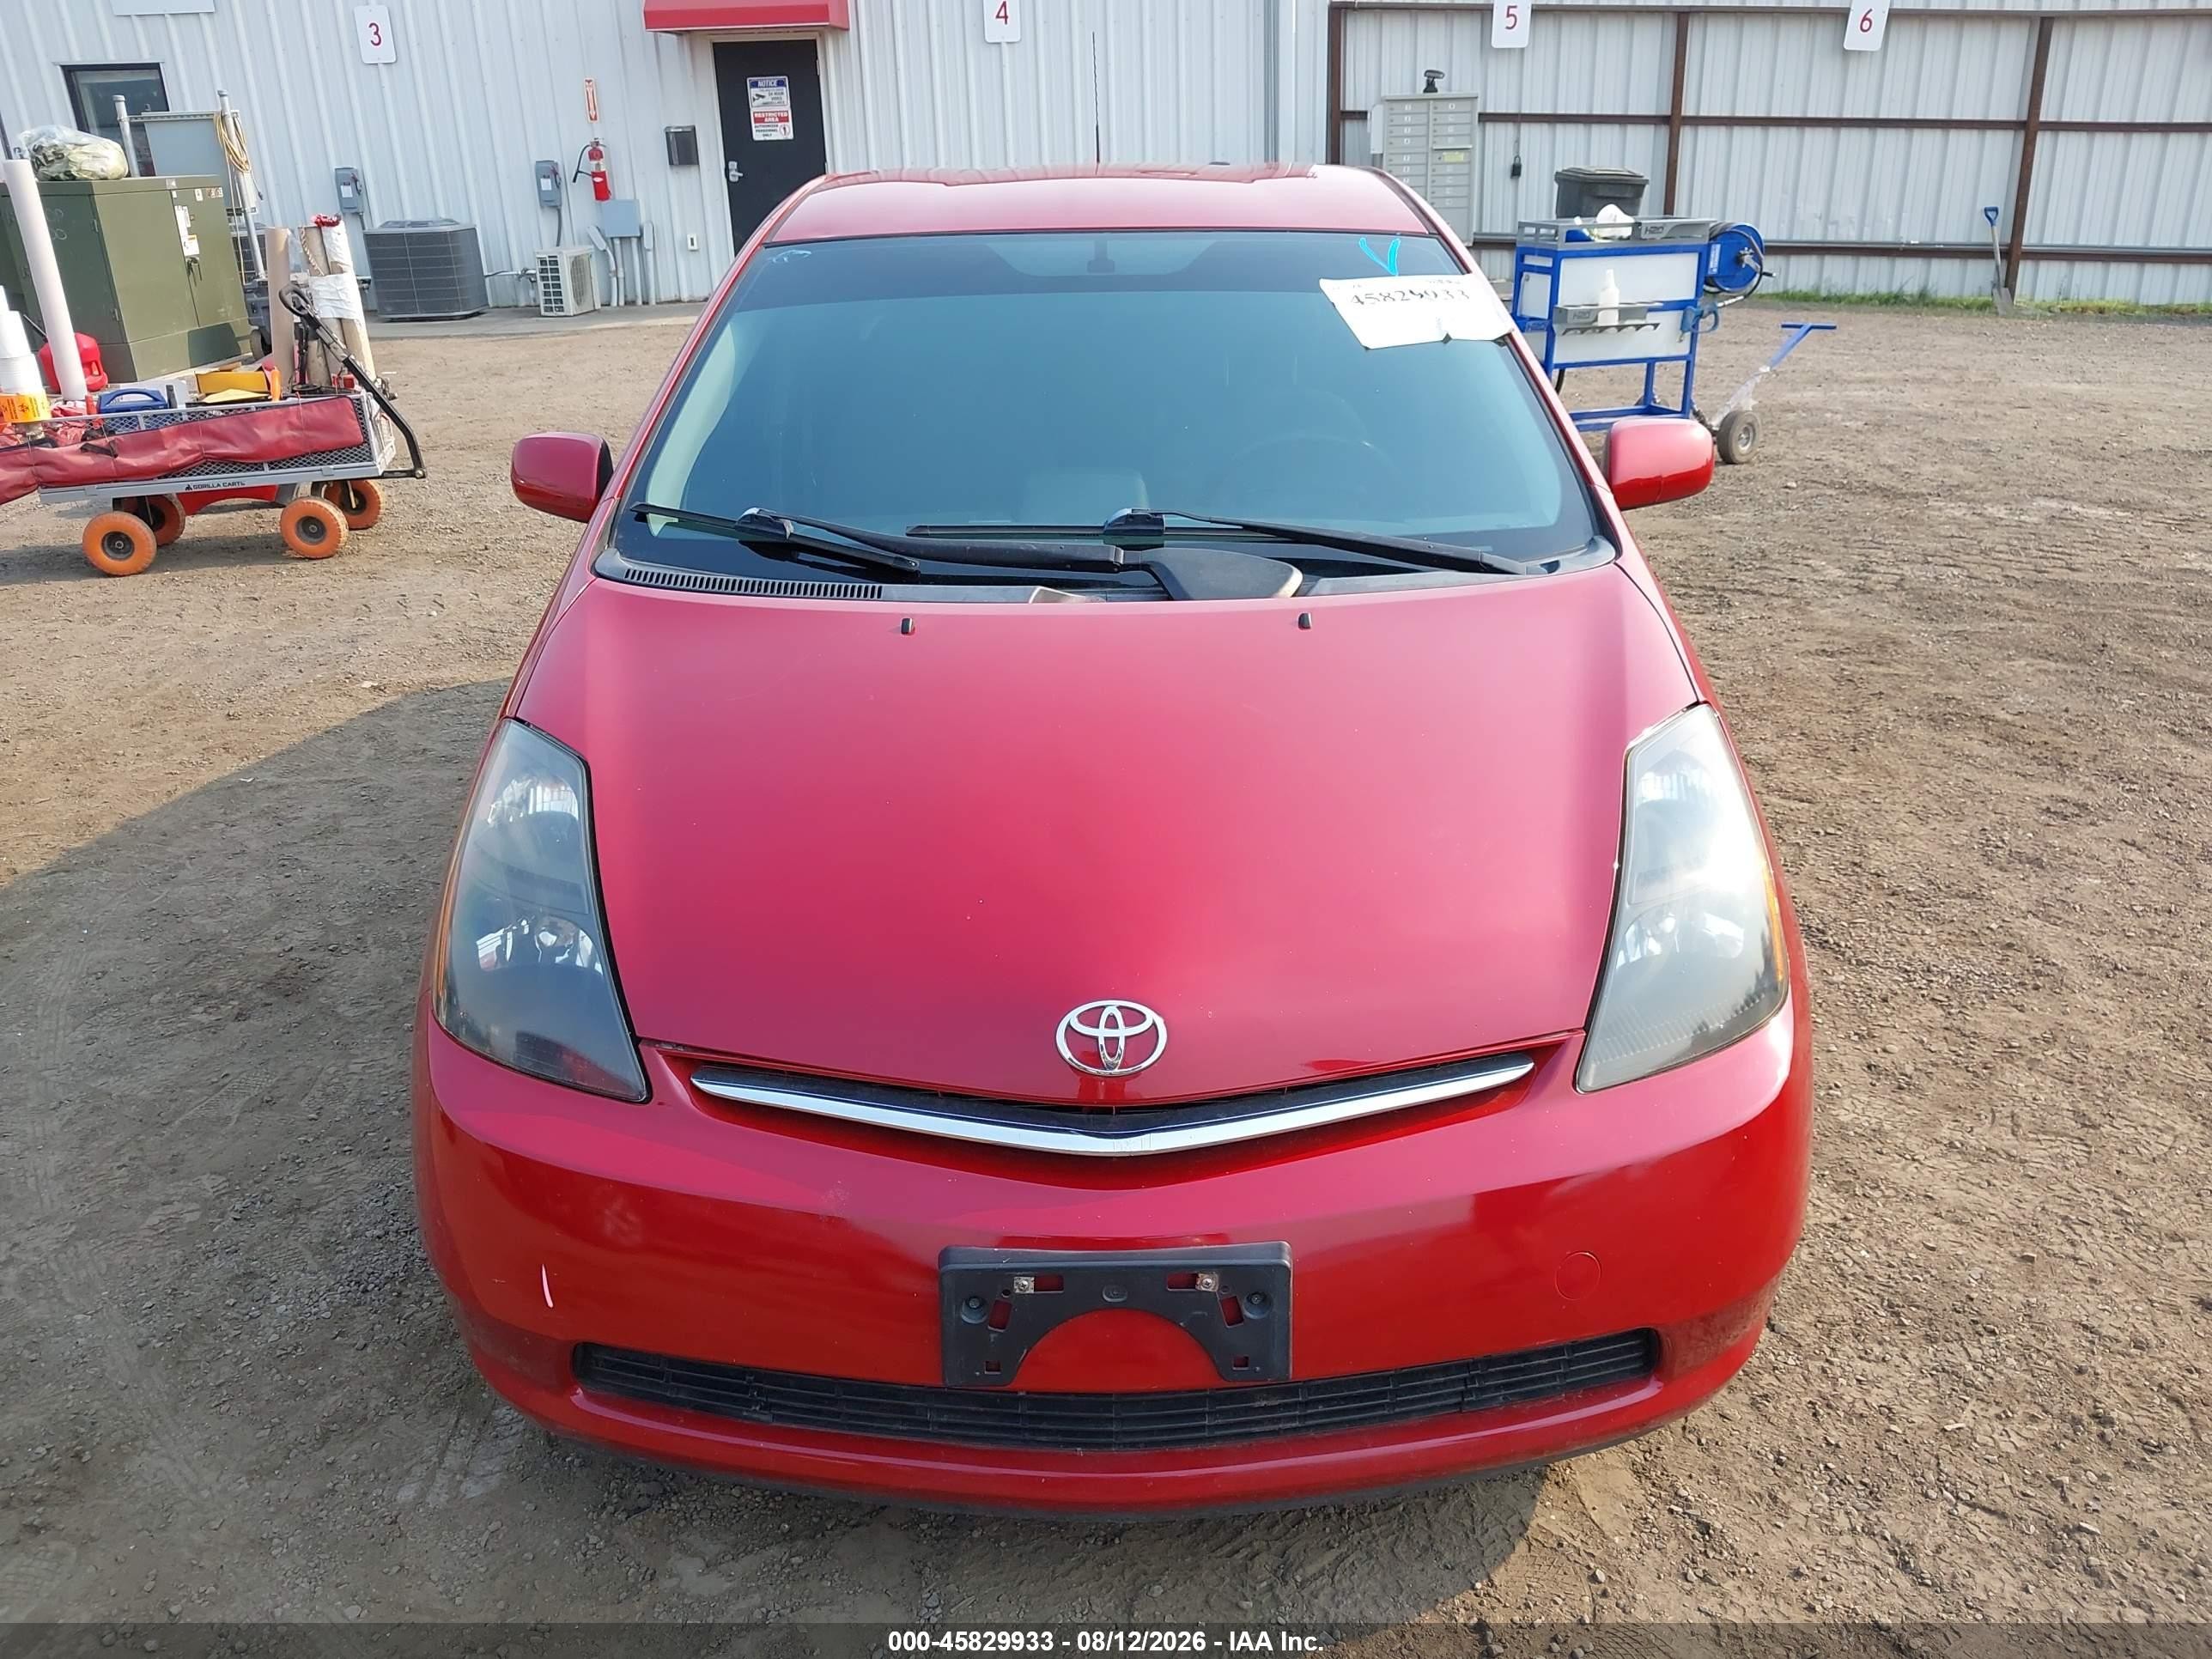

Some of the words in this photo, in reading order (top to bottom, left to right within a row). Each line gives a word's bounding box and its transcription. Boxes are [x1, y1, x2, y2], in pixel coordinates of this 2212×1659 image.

[995, 1, 1009, 25] 4
[1505, 5, 1517, 30] 5
[1860, 9, 1873, 33] 6
[368, 22, 381, 46] 3
